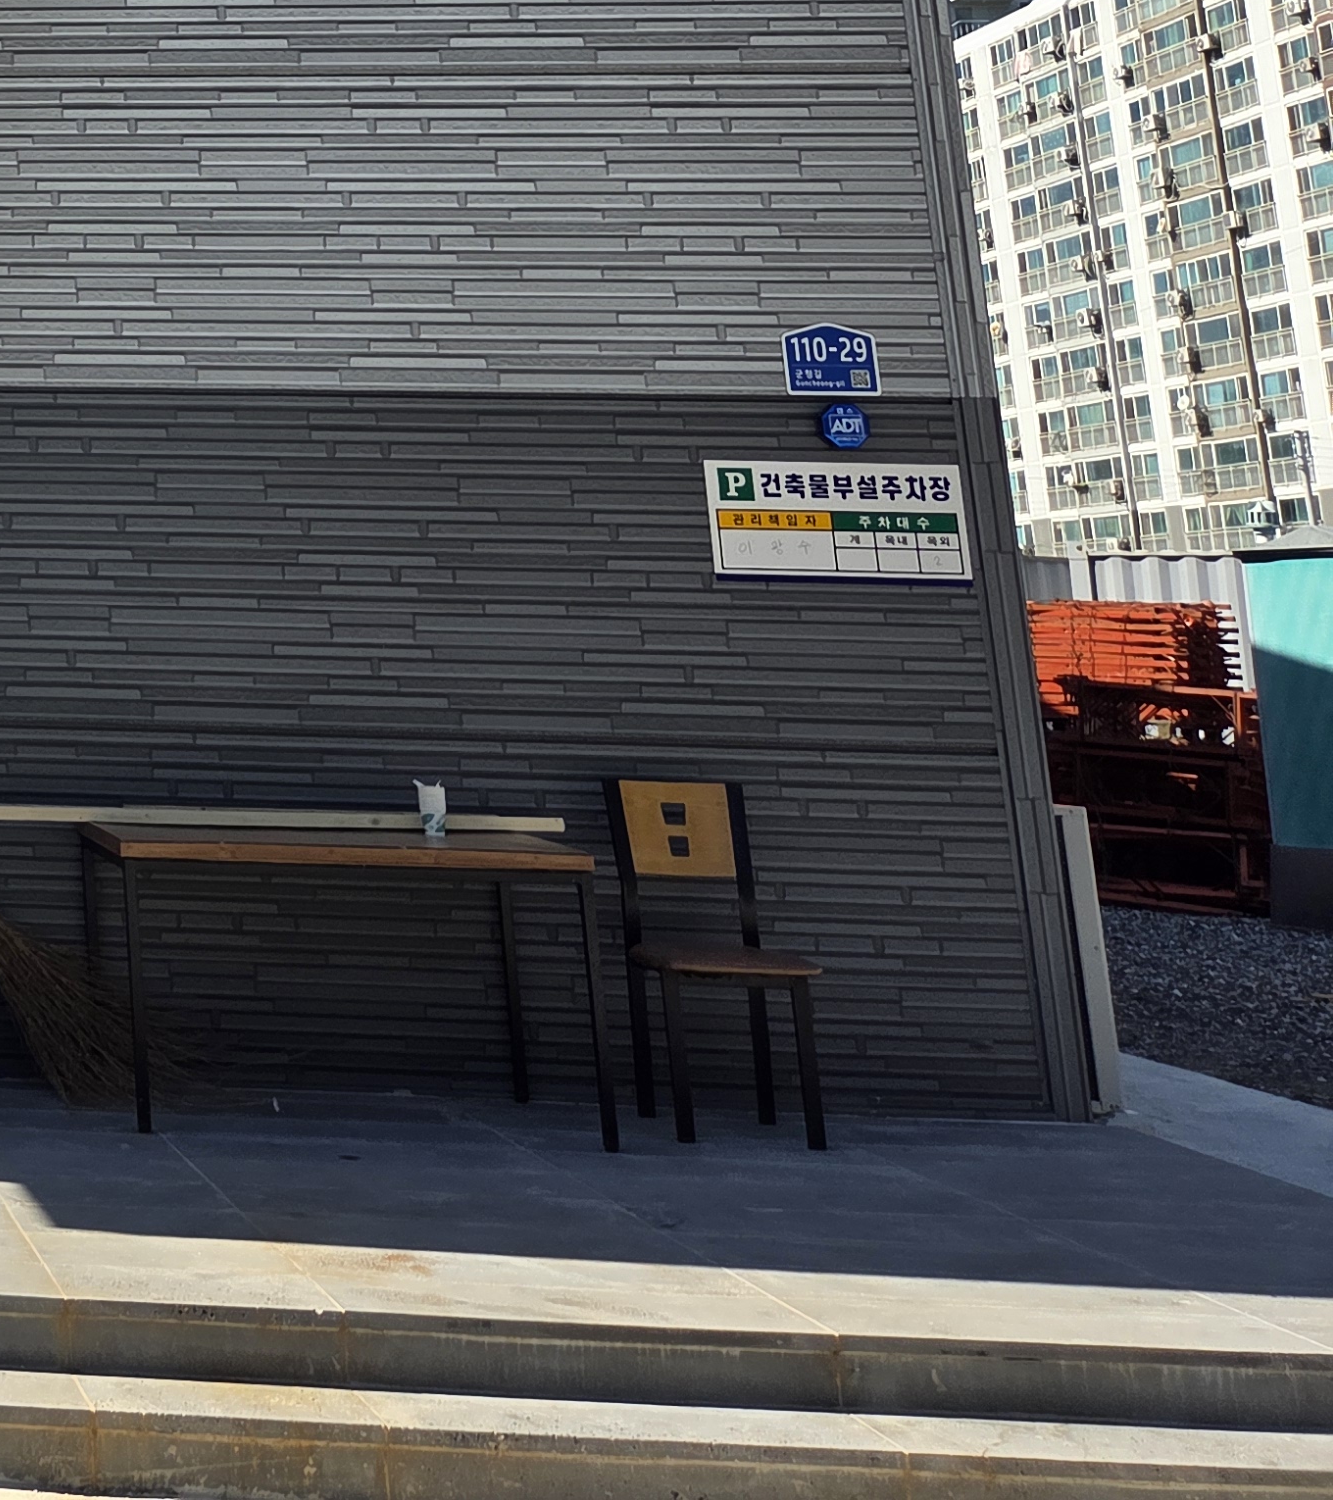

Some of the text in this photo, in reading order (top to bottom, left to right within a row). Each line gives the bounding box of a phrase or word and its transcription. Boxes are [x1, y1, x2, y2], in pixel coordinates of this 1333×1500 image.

[790, 337, 868, 363] 110-29
[831, 418, 862, 433] ADT
[725, 472, 951, 501] P 건축물부설주차장
